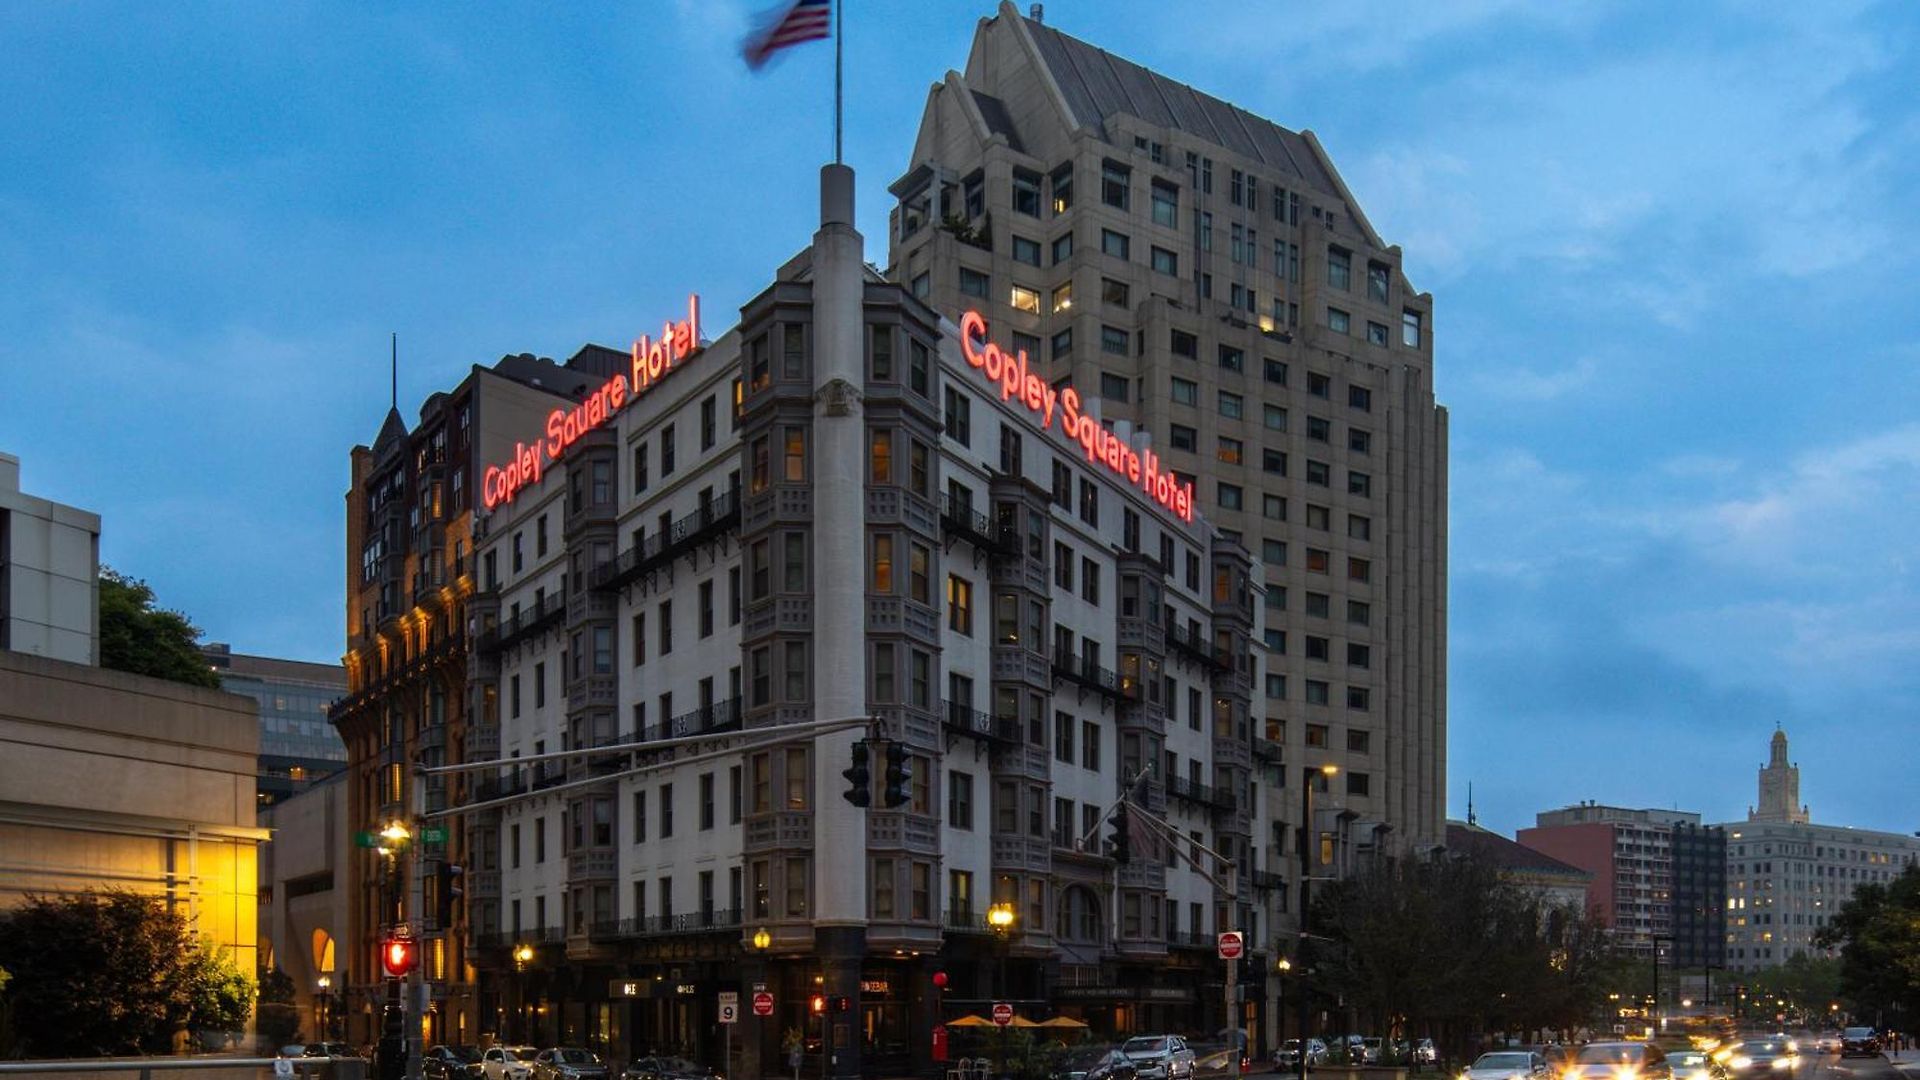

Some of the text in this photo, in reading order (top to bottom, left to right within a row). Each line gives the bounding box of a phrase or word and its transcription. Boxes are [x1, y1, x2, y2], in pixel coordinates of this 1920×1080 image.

[484, 292, 700, 510] Copley Square Hotel
[960, 308, 1193, 523] Copley Square Hotel
[723, 1006, 733, 1020] 9
